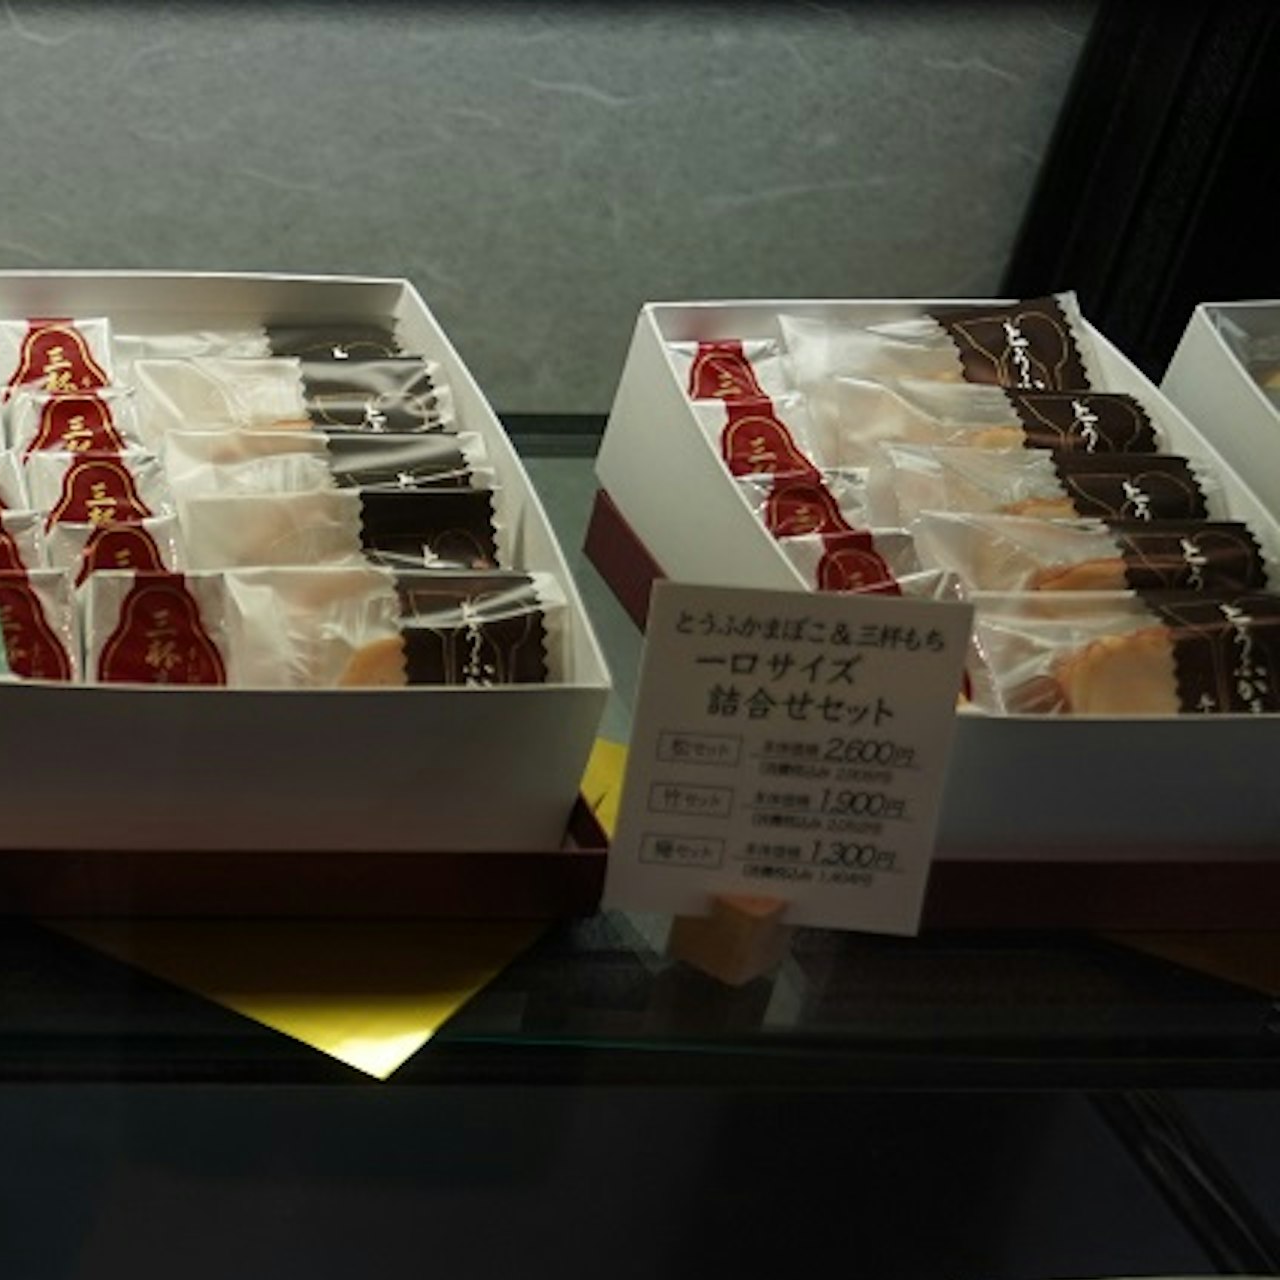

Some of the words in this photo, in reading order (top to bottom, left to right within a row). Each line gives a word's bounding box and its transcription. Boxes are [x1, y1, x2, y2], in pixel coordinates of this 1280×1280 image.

[695, 652, 863, 686] 一口サイズ
[707, 685, 896, 728] 詰合せセット
